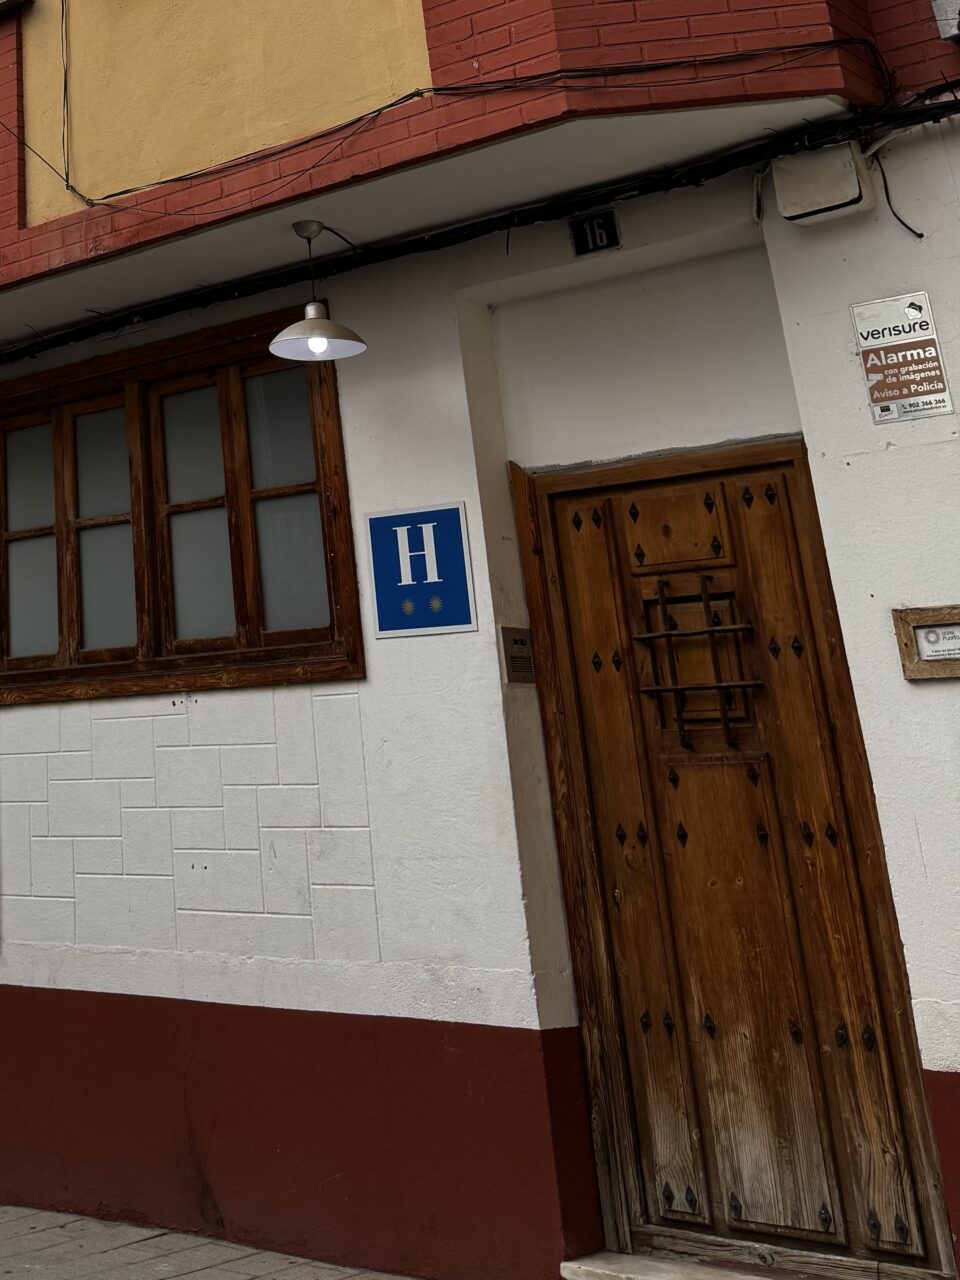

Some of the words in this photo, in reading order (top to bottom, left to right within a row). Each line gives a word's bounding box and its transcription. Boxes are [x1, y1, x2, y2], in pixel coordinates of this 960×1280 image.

[583, 218, 607, 249] 16
[860, 320, 929, 341] verisure
[866, 346, 937, 368] Alarma
[884, 367, 898, 375] con
[899, 361, 938, 374] grabación
[886, 374, 897, 383] de
[899, 369, 941, 382] imágenes
[873, 388, 900, 399] Aviso
[902, 387, 908, 395] a
[910, 381, 944, 393] Policía
[392, 522, 443, 586] H
